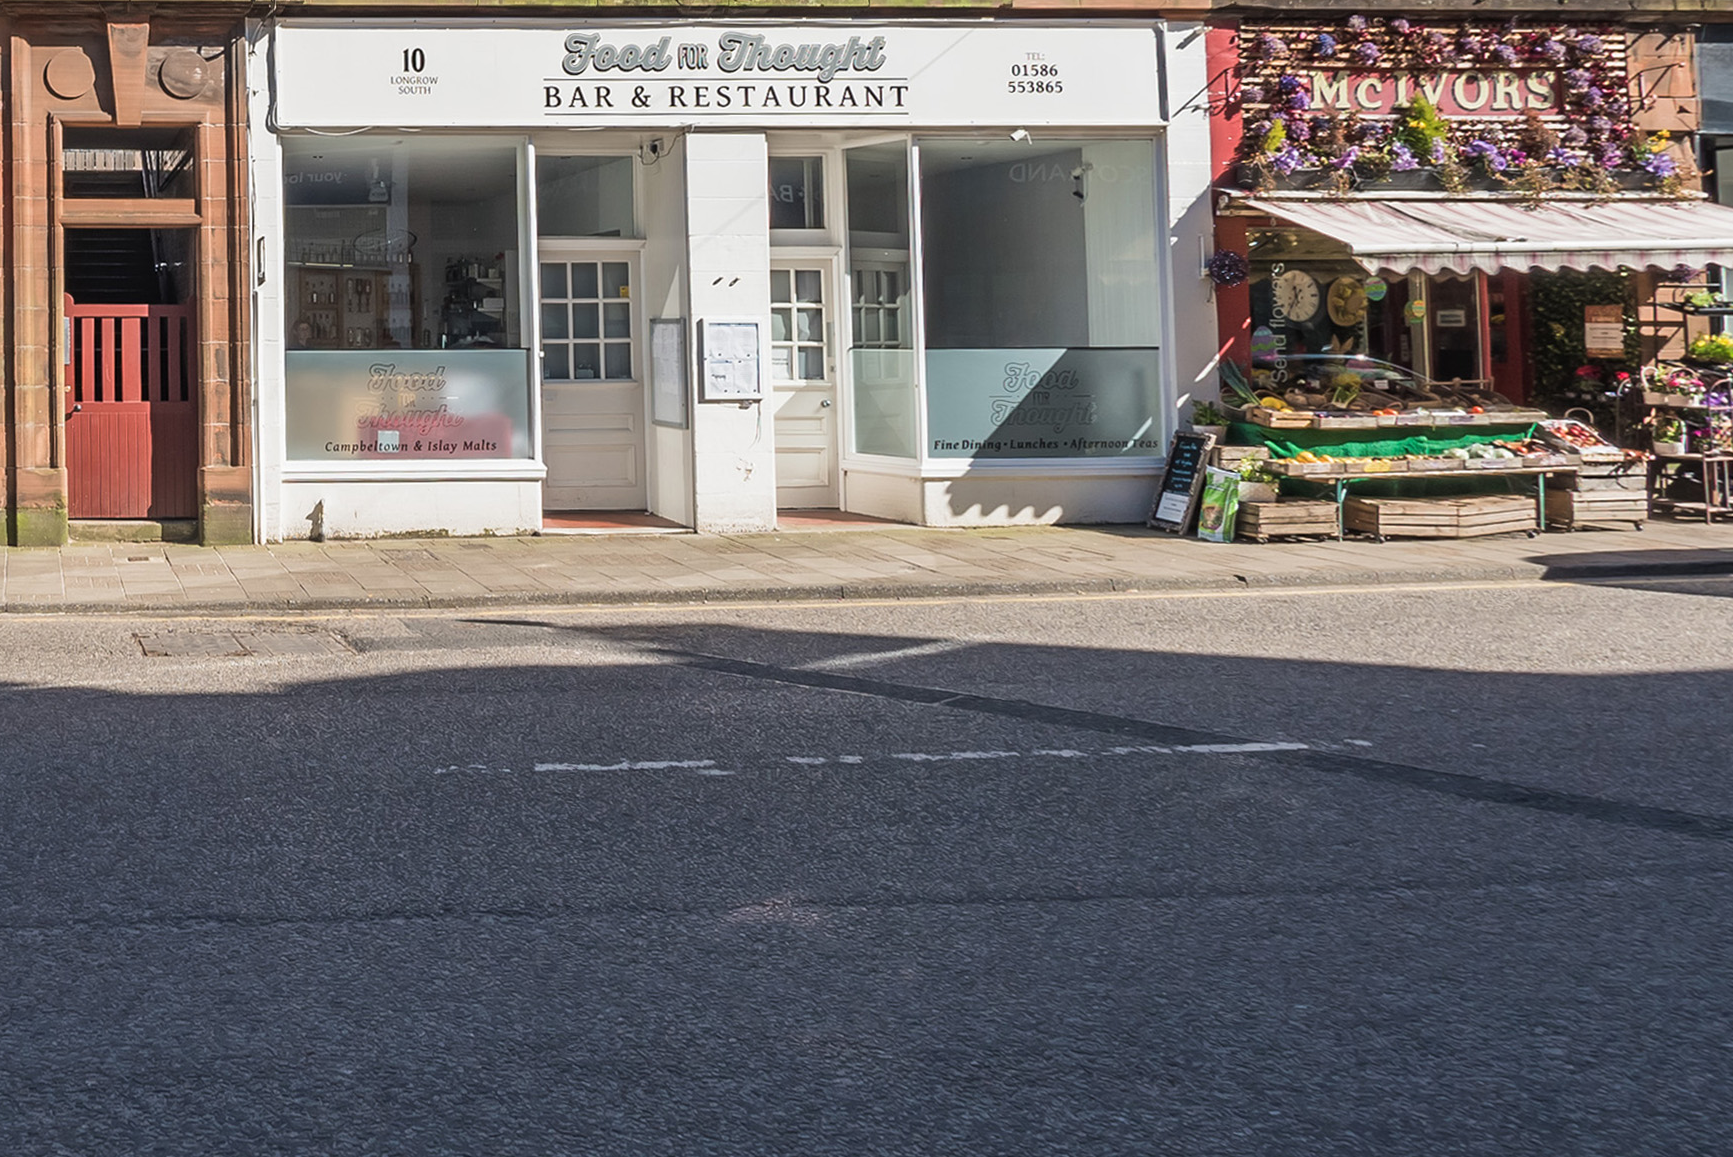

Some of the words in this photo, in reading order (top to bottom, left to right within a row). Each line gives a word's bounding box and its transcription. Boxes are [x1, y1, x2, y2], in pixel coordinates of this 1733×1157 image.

[403, 47, 426, 73] 10
[562, 31, 673, 75] Food
[678, 44, 709, 70] FOR
[717, 31, 886, 82] Thought
[1025, 52, 1045, 61] TEL:
[1011, 64, 1058, 77] 01586
[390, 76, 439, 85] LONGROW
[1008, 81, 1063, 94] 553865
[398, 86, 432, 95] SOUTH
[543, 85, 615, 108] BAR
[631, 85, 652, 108] &
[668, 85, 909, 108] RESTAURANT
[1269, 334, 1288, 383] Send
[368, 363, 446, 392] Food
[1003, 362, 1080, 392] Food
[324, 441, 408, 454] Campbeltown
[413, 441, 423, 451] &
[428, 440, 458, 454] Islay
[462, 439, 497, 451] Malts
[934, 440, 960, 450] Fine
[962, 439, 1002, 452] Dining
[1010, 439, 1059, 450] Lunches
[1070, 439, 1128, 451] Afternoon
